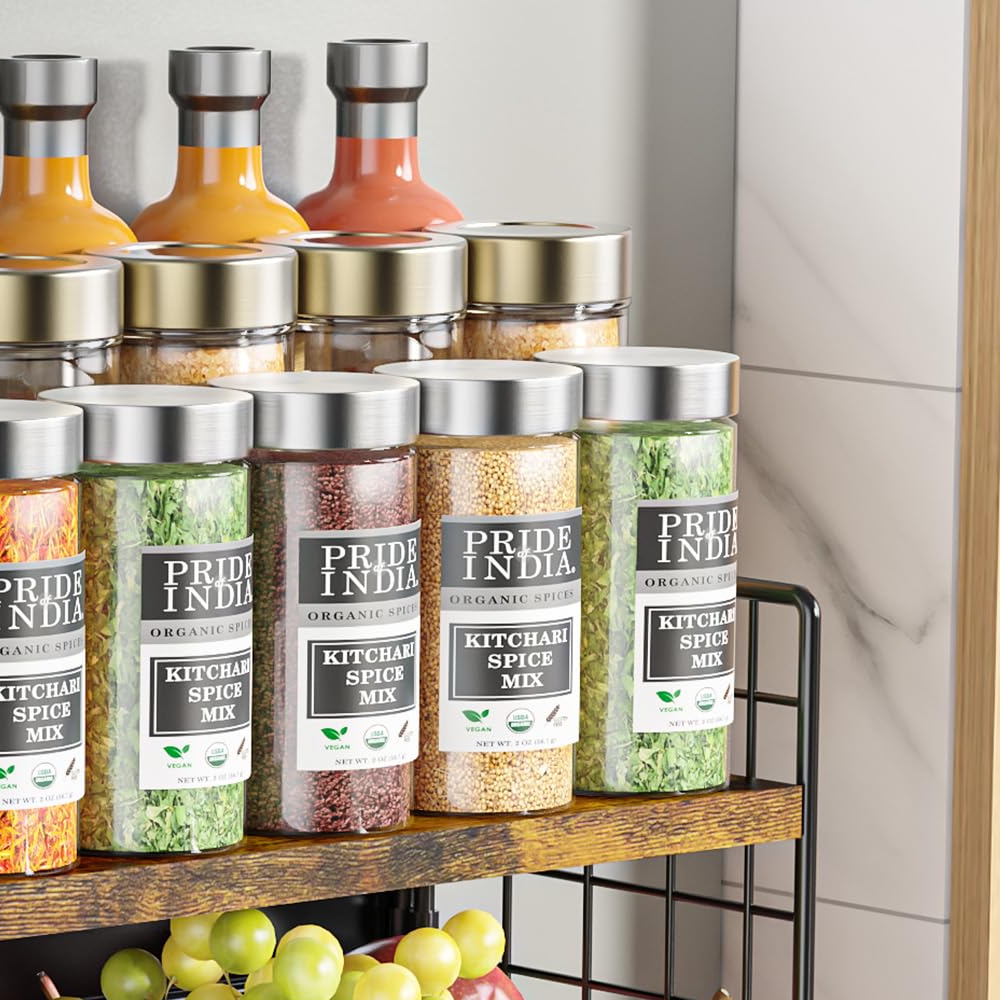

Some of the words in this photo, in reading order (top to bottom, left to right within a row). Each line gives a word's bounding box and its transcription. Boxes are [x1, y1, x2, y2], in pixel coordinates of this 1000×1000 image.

[657, 506, 738, 538] PRIDE
[463, 525, 572, 554] PRIDE
[321, 538, 416, 570] PRIDE
[163, 552, 252, 586] PRIDE
[644, 576, 713, 587] ORGANIC
[450, 594, 528, 605] ORGANIC
[534, 590, 574, 603] SPICES
[307, 609, 383, 620] ORGANIC
[150, 626, 225, 637] ORGANIC
[464, 628, 568, 648] KITCHARI
[680, 630, 729, 649] SPICE
[322, 642, 414, 665] KITCHARI
[487, 651, 553, 669] SPICE
[691, 651, 723, 669] MIX
[165, 657, 250, 682] KITCHARI
[345, 665, 404, 686] SPICE
[501, 672, 544, 689] MIX
[188, 681, 242, 703] SPICE
[358, 687, 397, 705] MIX
[12, 701, 71, 723] SPICE
[200, 704, 236, 723] MIX
[26, 724, 64, 743] MIX
[177, 776, 195, 784] NET
[1, 797, 20, 805] NET
